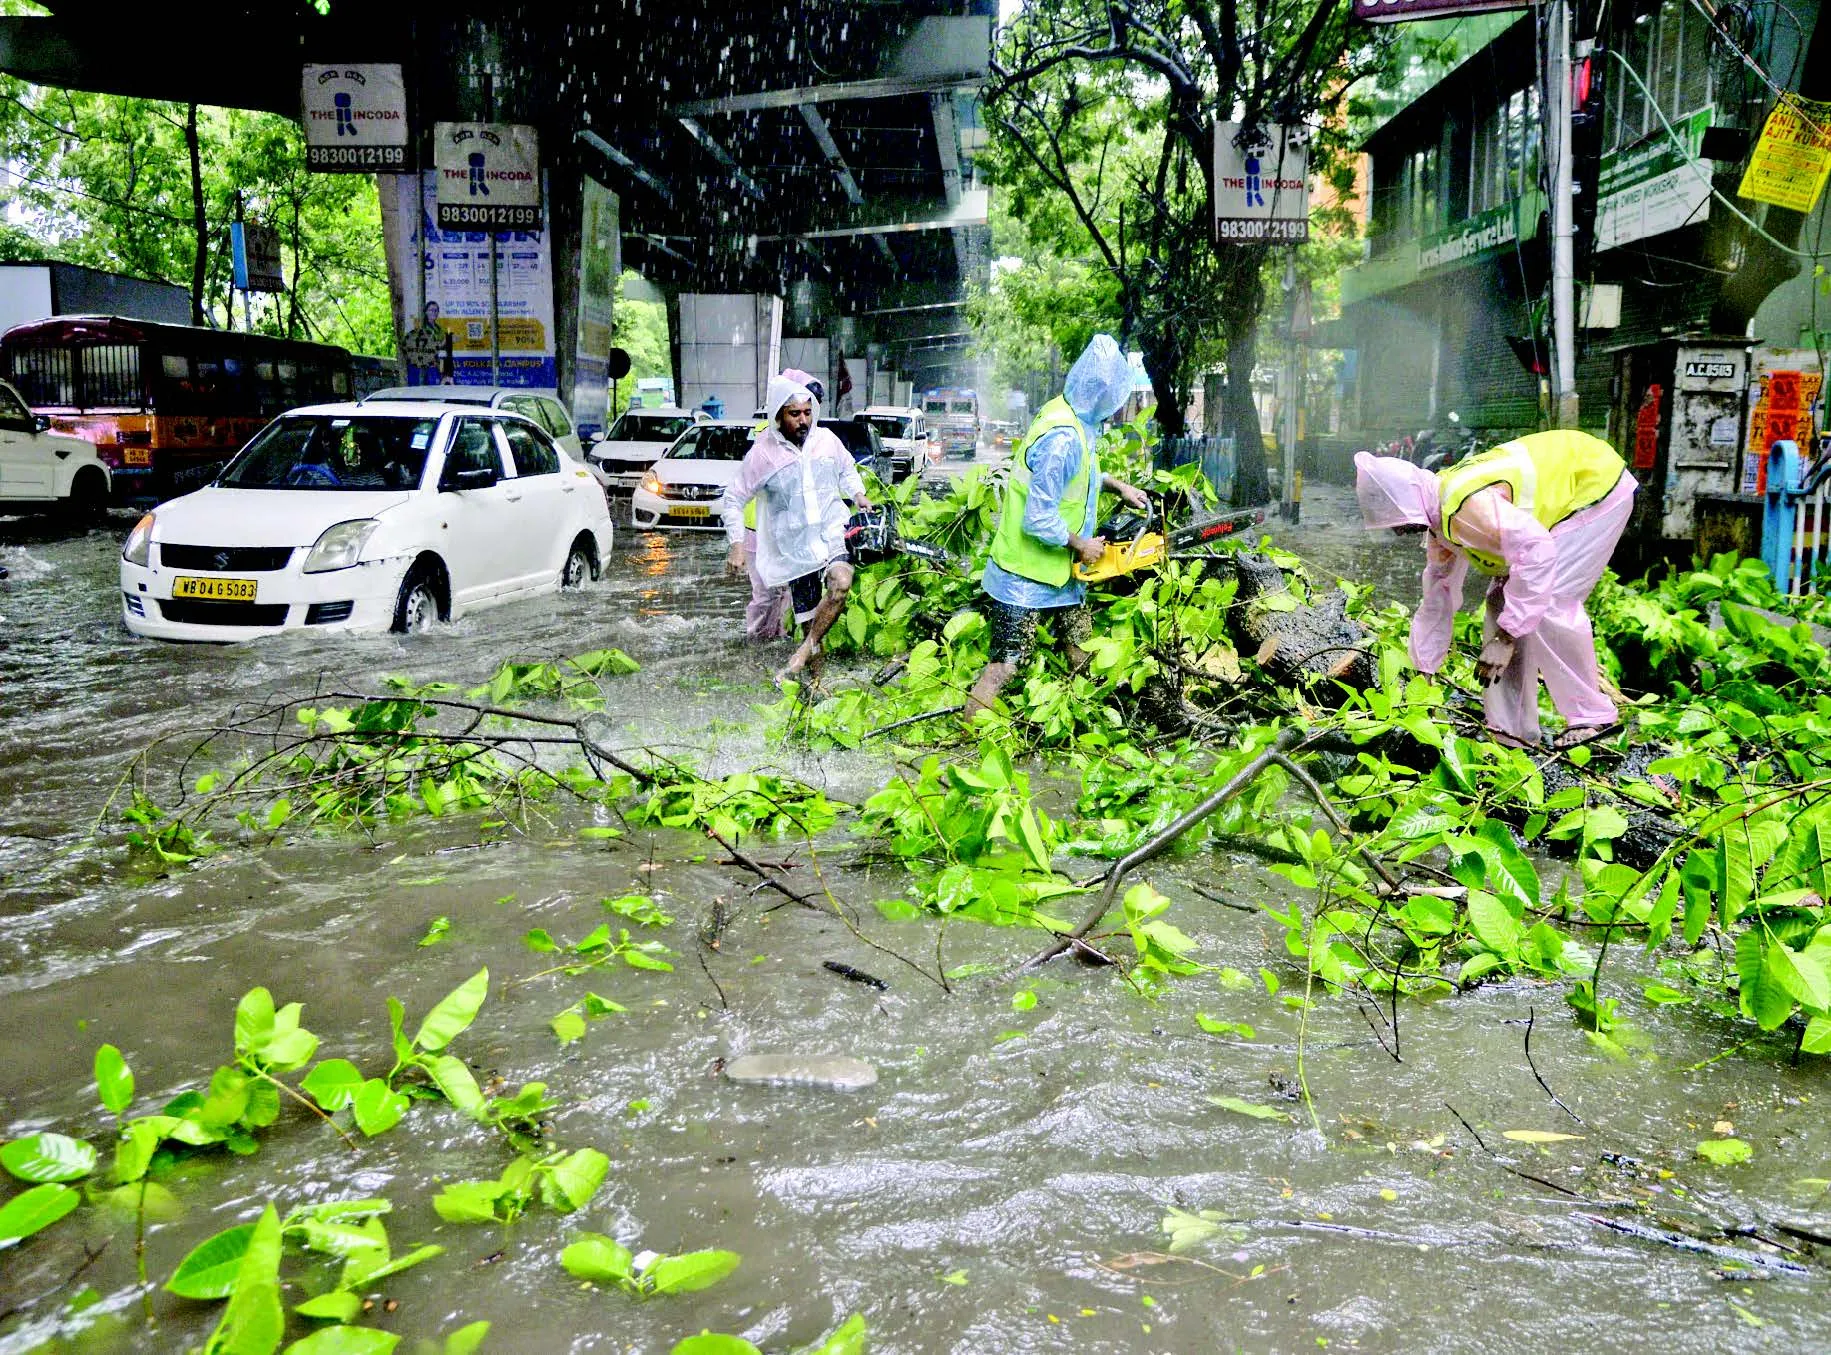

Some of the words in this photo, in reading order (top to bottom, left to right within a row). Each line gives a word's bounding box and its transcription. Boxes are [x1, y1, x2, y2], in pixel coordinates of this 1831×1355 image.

[310, 110, 335, 120] THE
[310, 148, 404, 164] 9830012199
[443, 169, 468, 179] THE
[1222, 178, 1245, 189] THE
[441, 206, 534, 223] 9830012199
[1220, 221, 1306, 239] 9830012199
[183, 580, 197, 594] WB
[199, 582, 213, 595] 04
[217, 583, 223, 595] G
[226, 583, 255, 597] 5083
